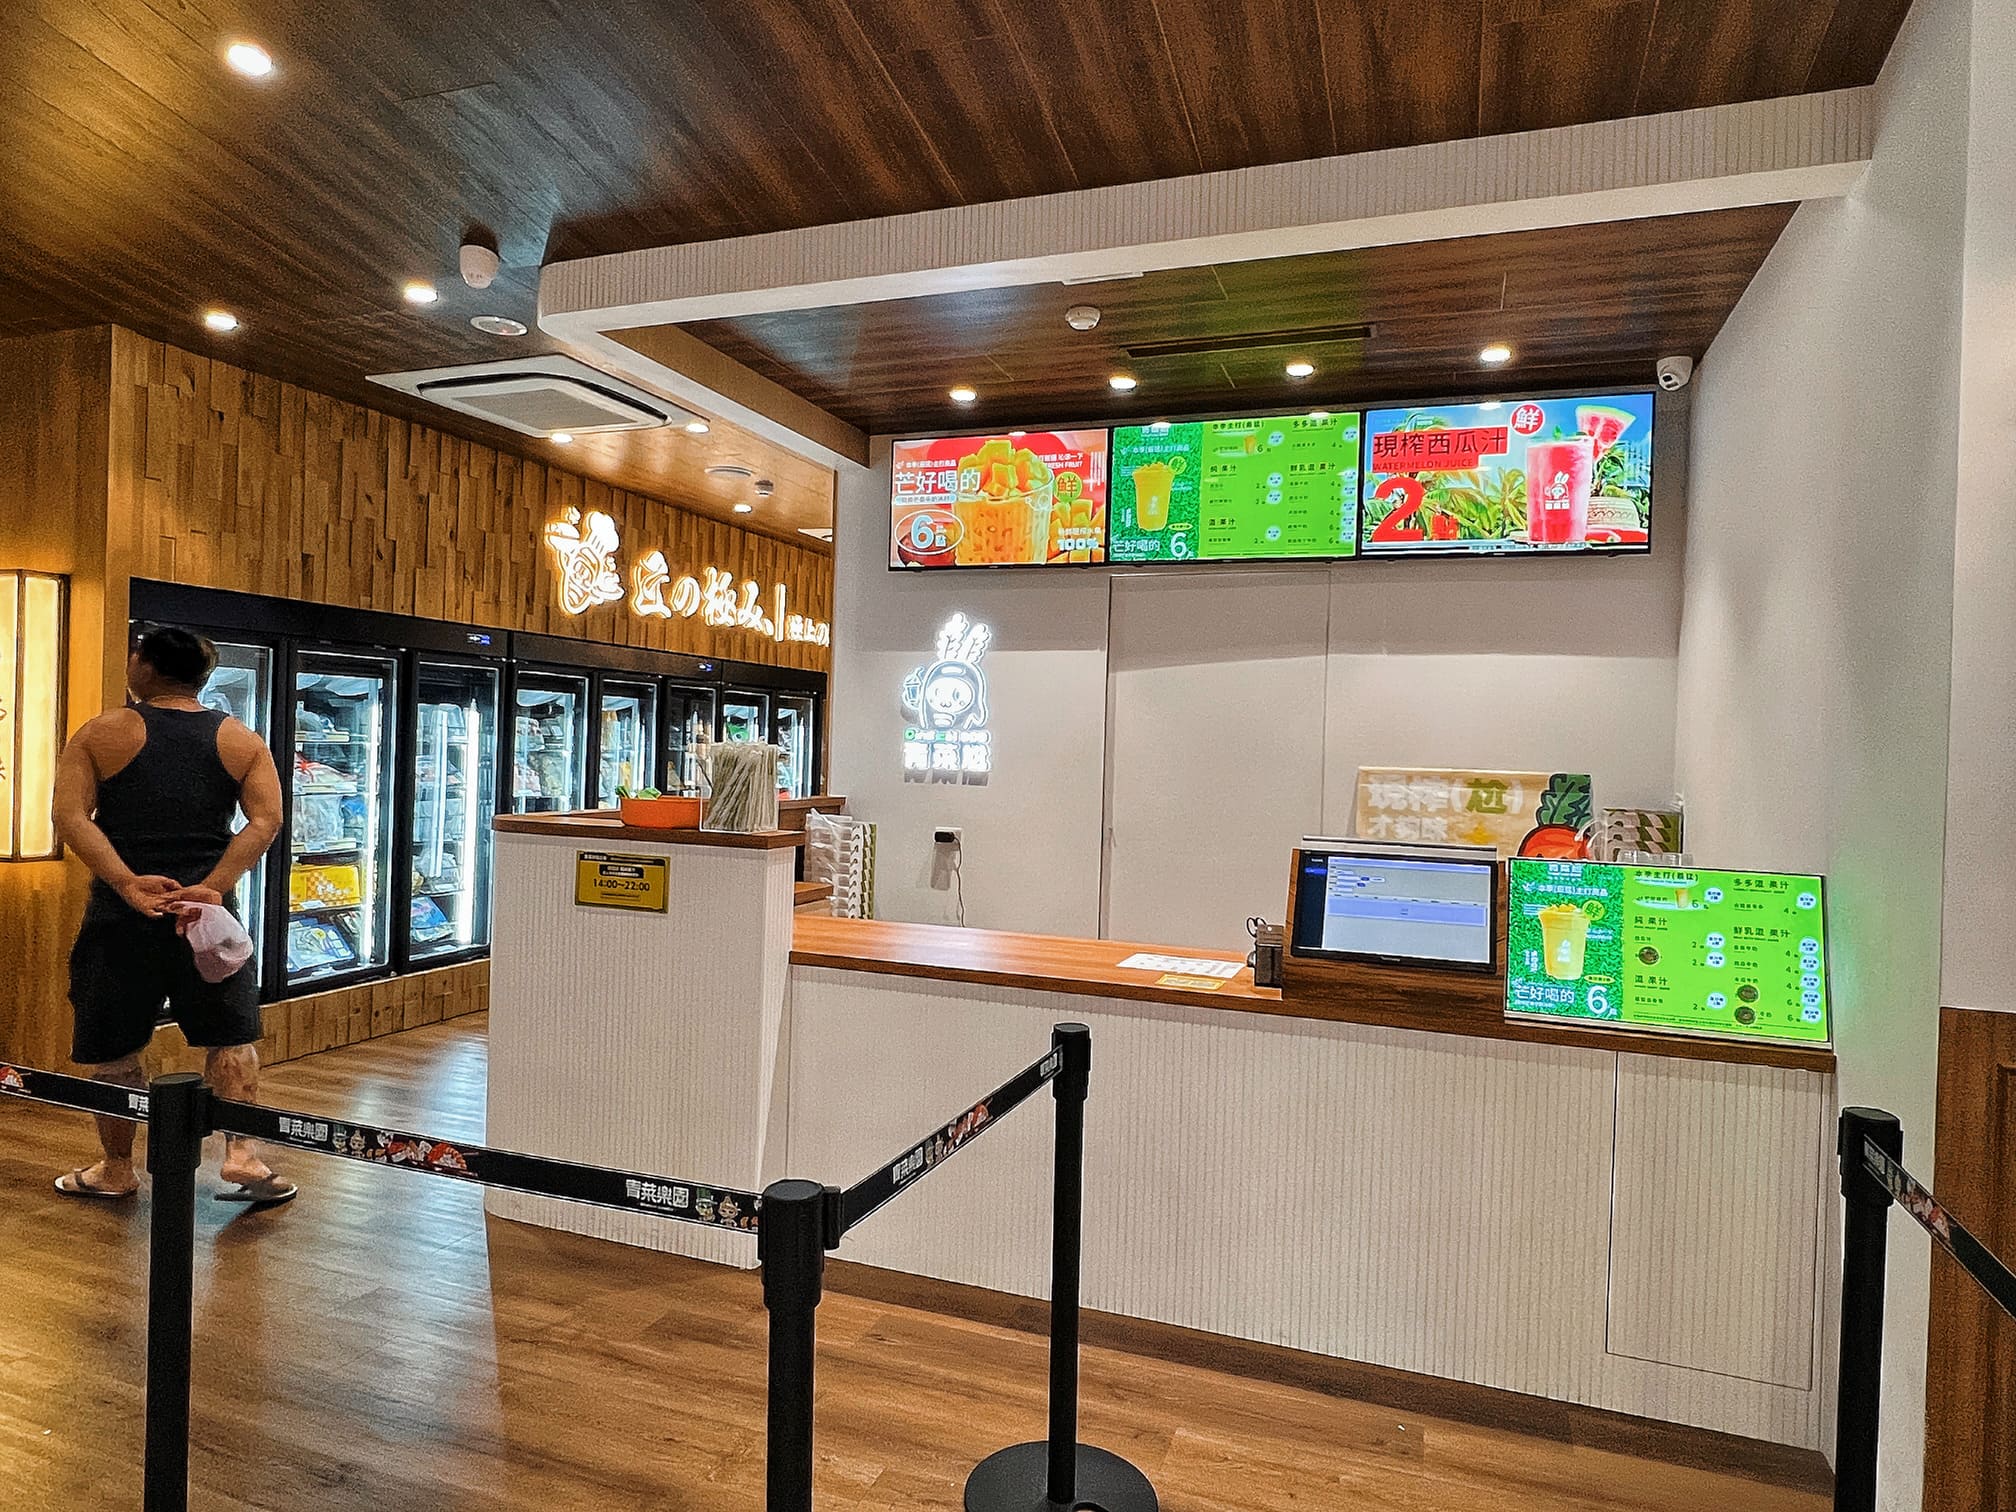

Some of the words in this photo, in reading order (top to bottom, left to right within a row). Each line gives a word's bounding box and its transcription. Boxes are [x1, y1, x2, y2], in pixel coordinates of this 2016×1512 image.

[1514, 408, 1541, 432] 鮮
[1373, 427, 1506, 458] 現榨西瓜汁
[1372, 460, 1441, 471] WATERMELON
[1444, 458, 1473, 468] JUICE
[895, 468, 981, 494] 芒好喝的
[1057, 475, 1078, 497] 鮮
[1372, 477, 1424, 542] 2
[911, 514, 935, 549] 6
[1057, 537, 1099, 551] 100%
[1170, 531, 1187, 558] 6
[593, 878, 650, 891] 14:00~22:00
[1514, 984, 1575, 1003] 芒好喝的
[1588, 985, 1609, 1015] 6
